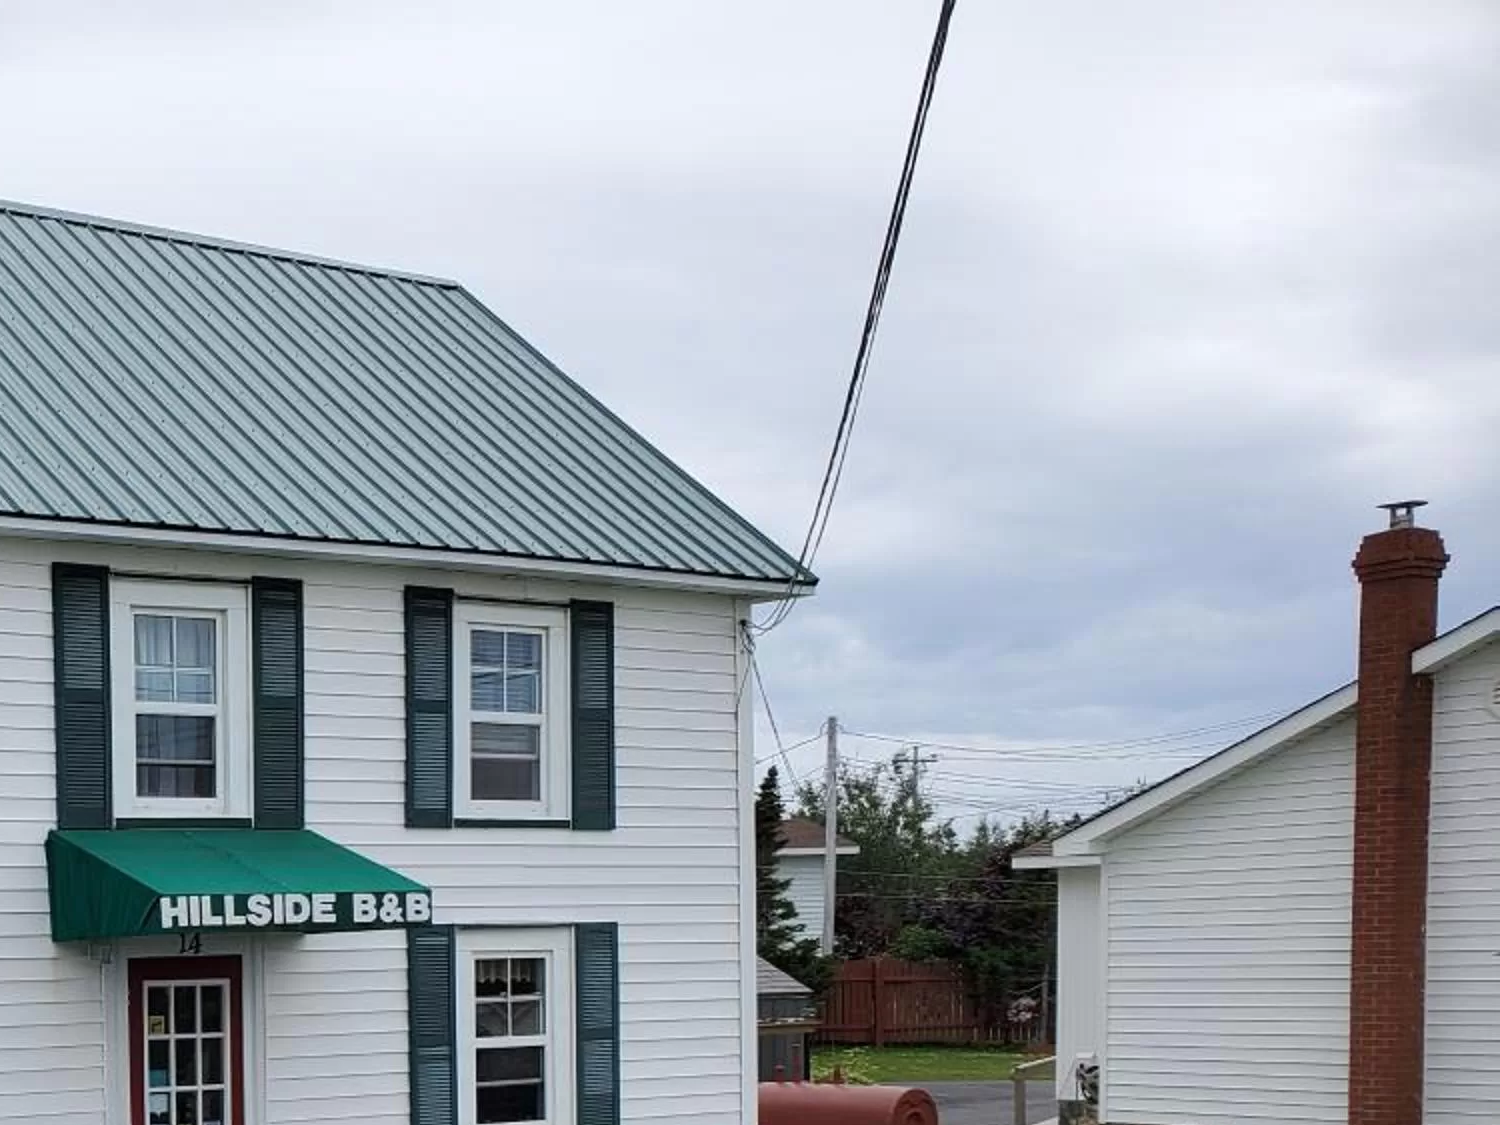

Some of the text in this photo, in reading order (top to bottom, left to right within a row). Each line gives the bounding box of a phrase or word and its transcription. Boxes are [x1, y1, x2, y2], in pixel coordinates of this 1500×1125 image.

[159, 892, 431, 929] HILLSIDE B&B
[180, 932, 202, 954] 14
